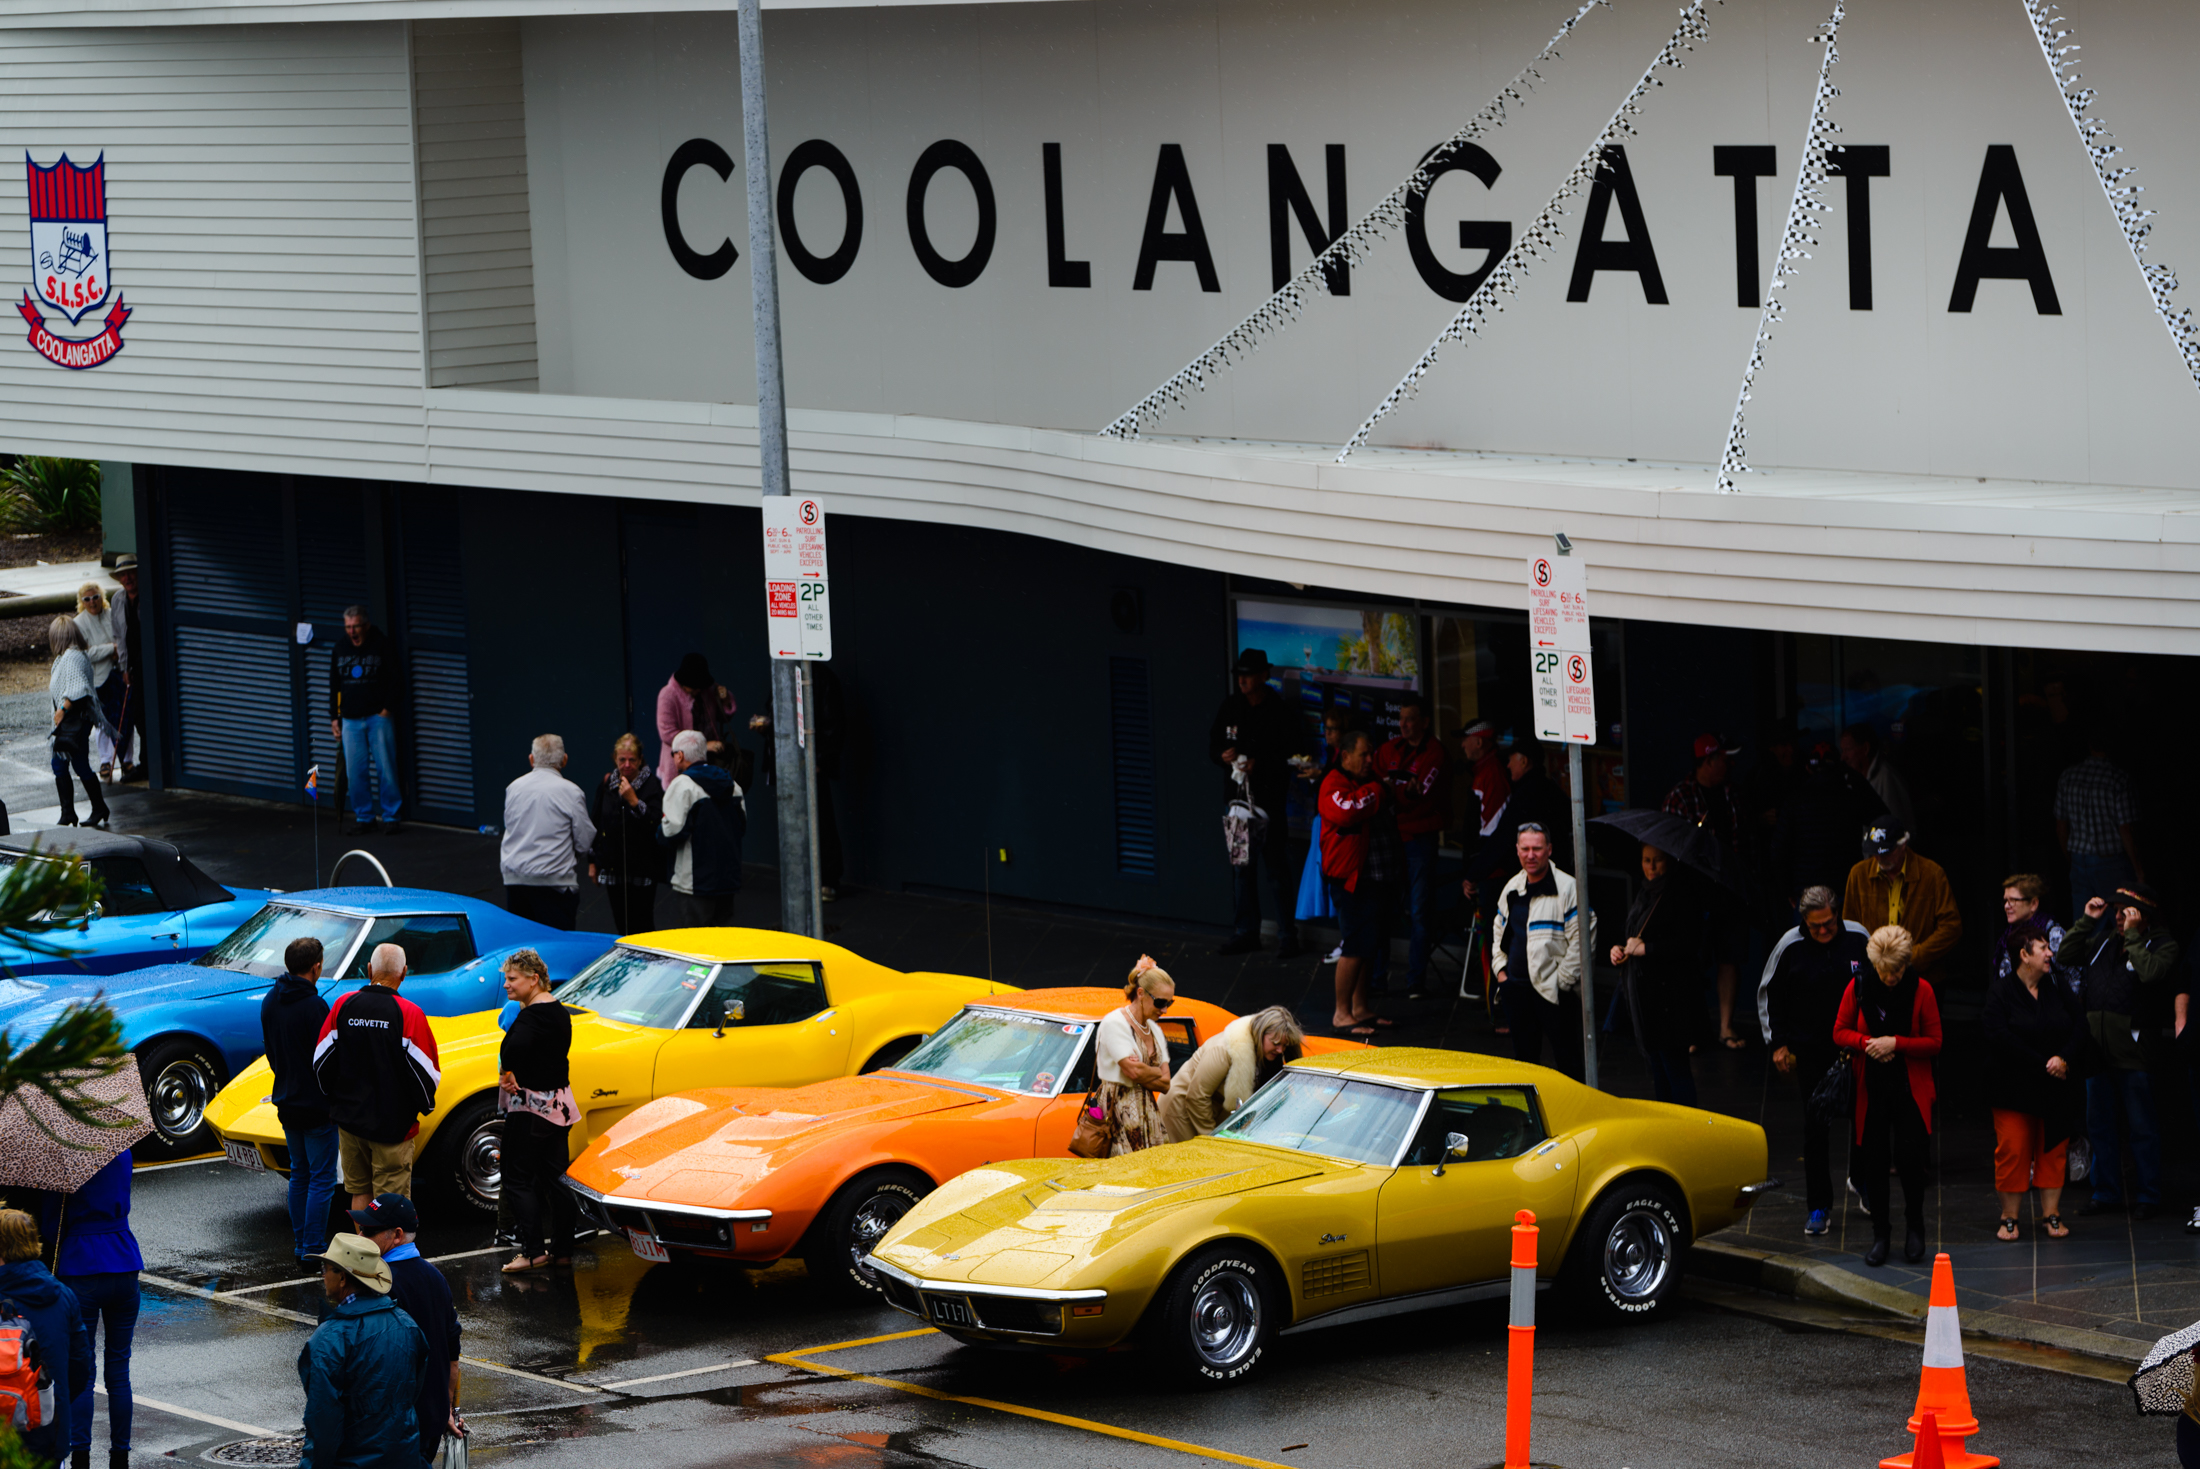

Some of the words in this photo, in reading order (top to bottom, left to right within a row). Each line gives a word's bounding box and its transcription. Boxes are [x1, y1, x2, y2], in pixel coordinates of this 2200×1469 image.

[661, 138, 2063, 316] COOLANGATTA
[36, 329, 116, 367] COOLANGATTA
[796, 527, 824, 535] PATROLLING
[805, 535, 817, 543] SURF
[798, 543, 825, 551] LIFESAVING
[800, 559, 824, 567] EXCEPTED
[769, 583, 796, 593] LOADING
[800, 583, 825, 602] 2P
[1530, 588, 1557, 599] PATROLLING
[774, 592, 793, 602] ZONE
[1539, 598, 1551, 607] SURF
[804, 612, 824, 621] OTHER
[1532, 607, 1558, 617] LIFESAVING
[806, 622, 823, 631] TIMES
[1533, 616, 1556, 626] VEHICLES
[1534, 625, 1557, 635] EXCEPTED
[1535, 652, 1559, 674] 2P
[1542, 676, 1553, 685] ALL
[1539, 687, 1557, 697] OTHER
[1566, 685, 1591, 696] LIFEGUARD
[1540, 697, 1557, 708] TIMES
[1567, 695, 1590, 705] VEHICLES
[1568, 704, 1591, 715] EXCEPTED
[980, 1010, 1033, 1024] CORVETTE
[347, 1018, 390, 1029] CORVETTE
[877, 1184, 921, 1203] HERCULE
[465, 1193, 499, 1212] ENGER
[1626, 1199, 1662, 1211] EAGLE
[1192, 1259, 1256, 1294] GOODYEAR
[1600, 1276, 1657, 1312] GOODYEAR
[1228, 1346, 1263, 1379] EAGLE
